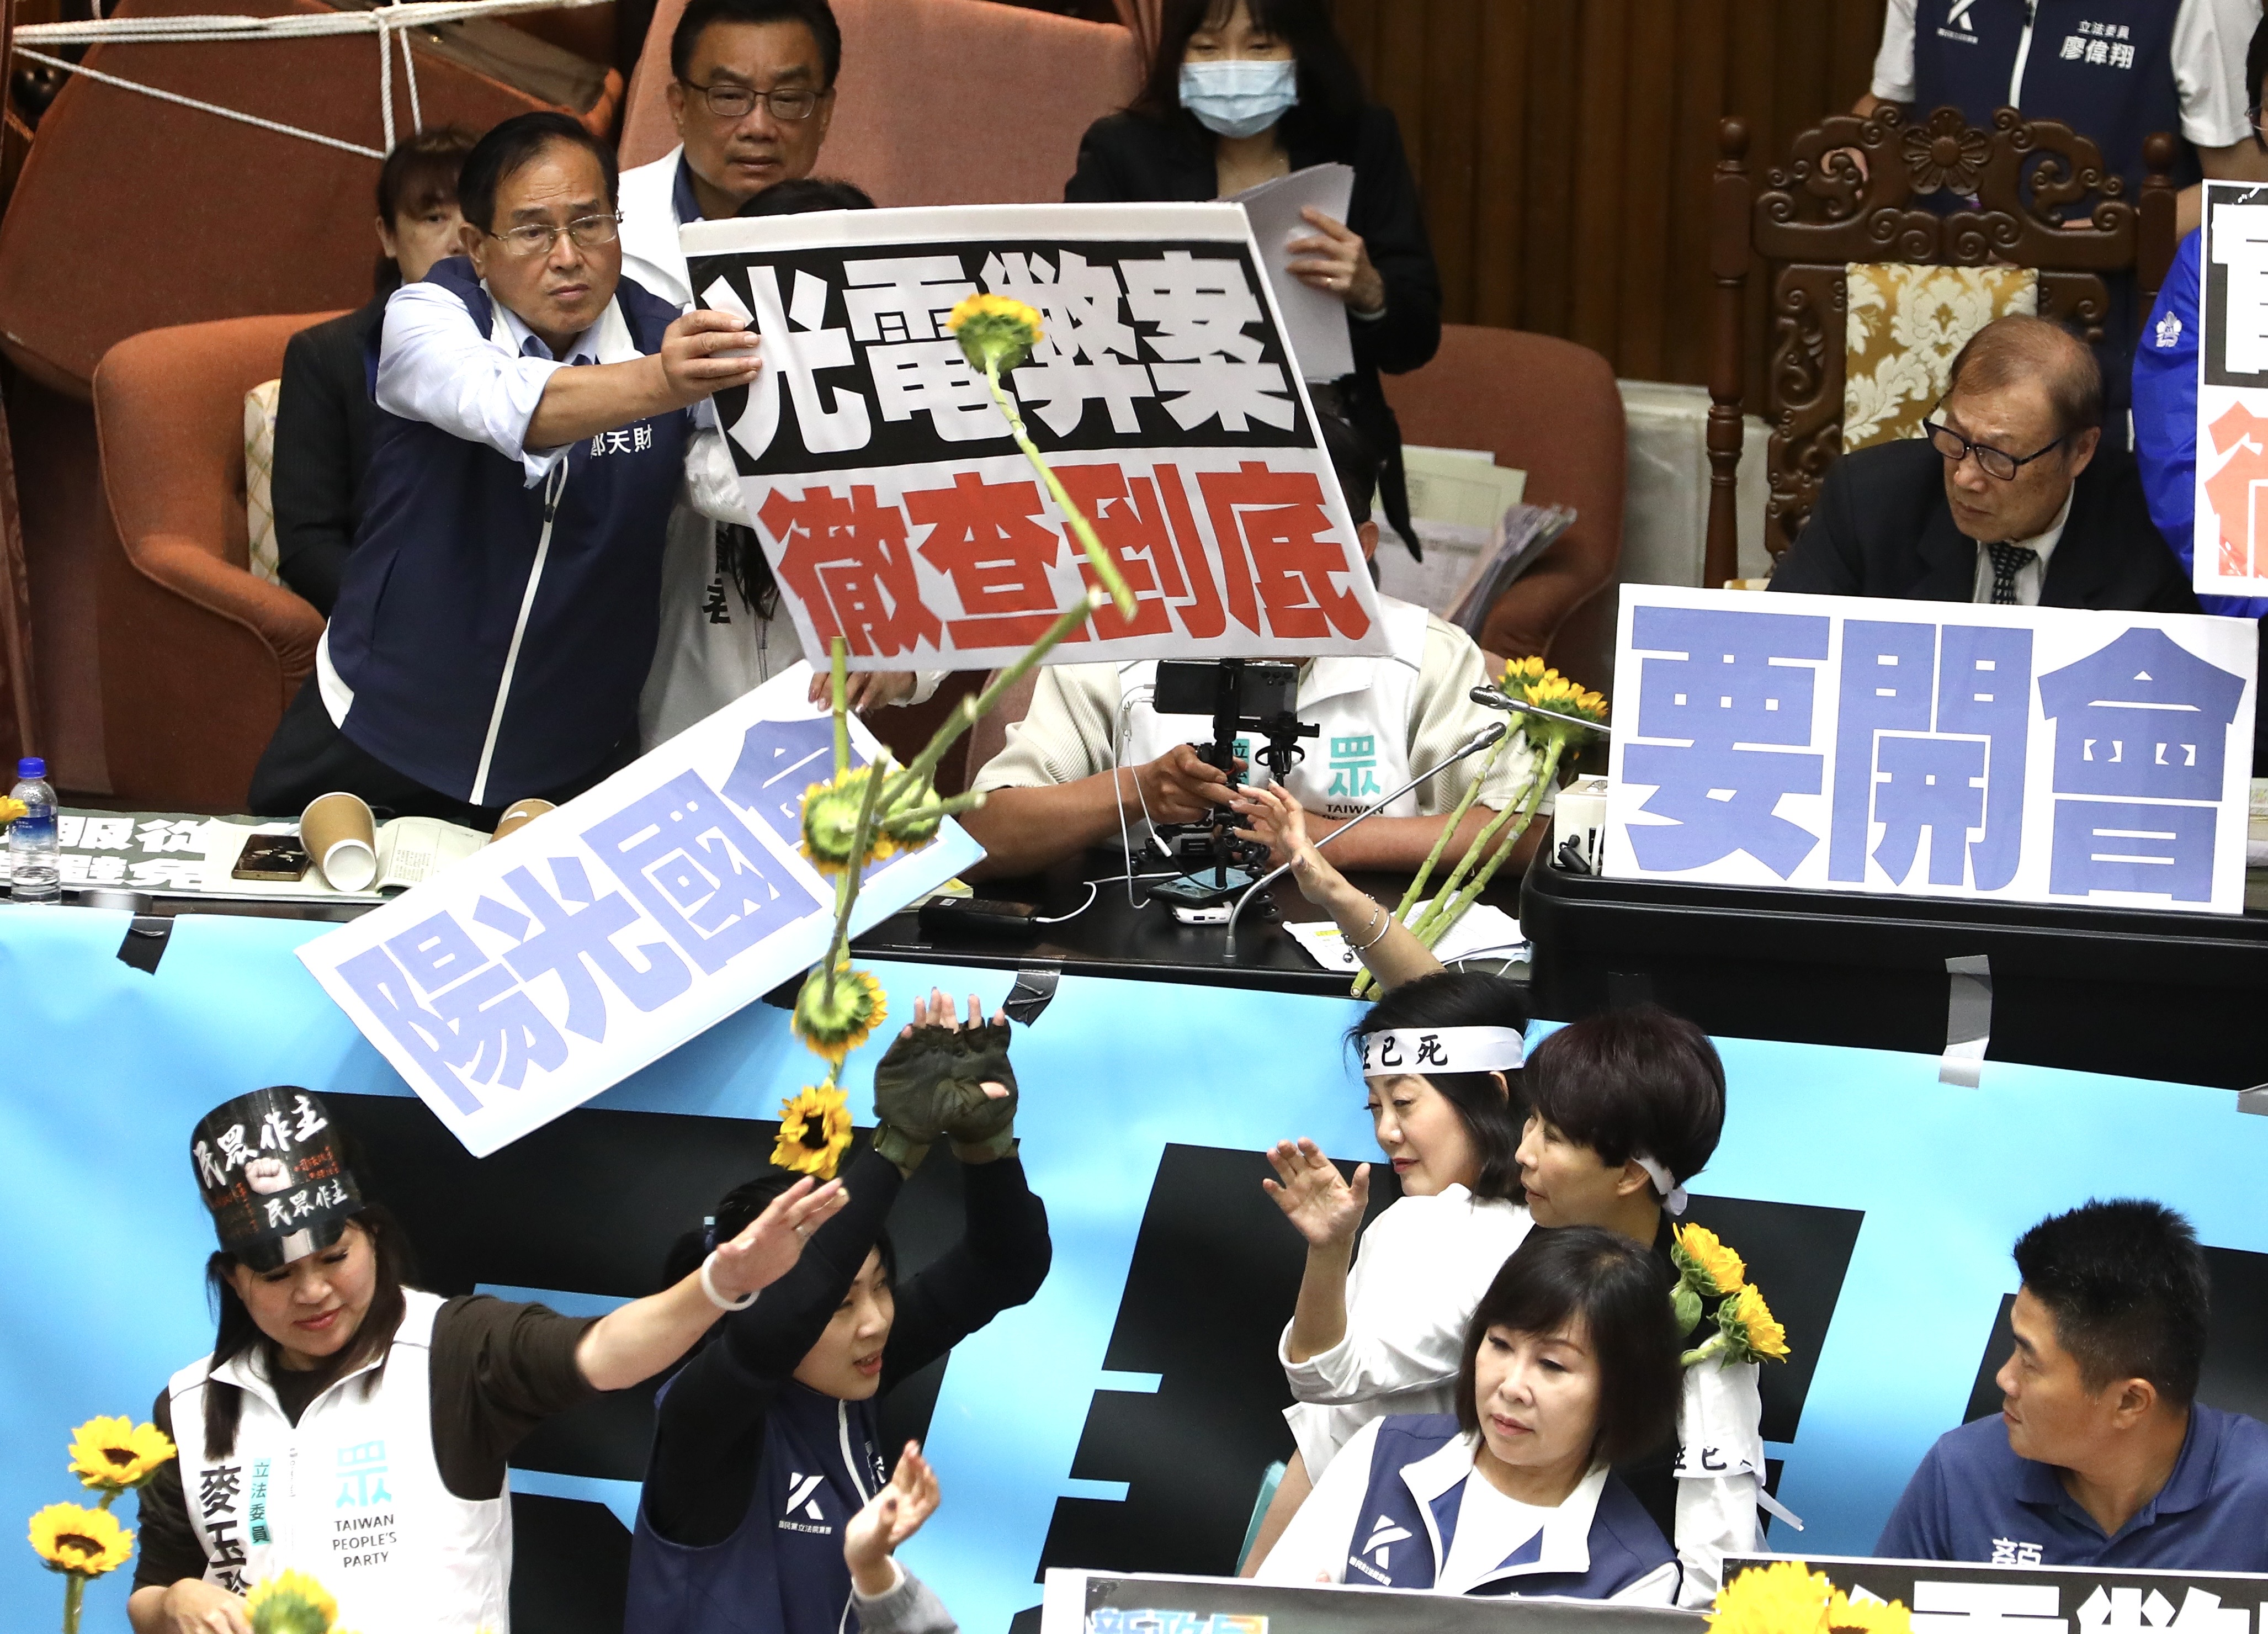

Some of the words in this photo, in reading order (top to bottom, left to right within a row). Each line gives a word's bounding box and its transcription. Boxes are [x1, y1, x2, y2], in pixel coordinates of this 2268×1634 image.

[2059, 35, 2136, 70] 廖偉翔
[2076, 20, 2129, 40] 立法委員
[701, 250, 1295, 460] 光電弊案
[757, 461, 1371, 657] 徹查到底
[1621, 605, 2246, 903] 要開會
[249, 1462, 270, 1543] 立法委員
[334, 1514, 394, 1532] TAIWAN
[343, 1551, 389, 1568] PARTY
